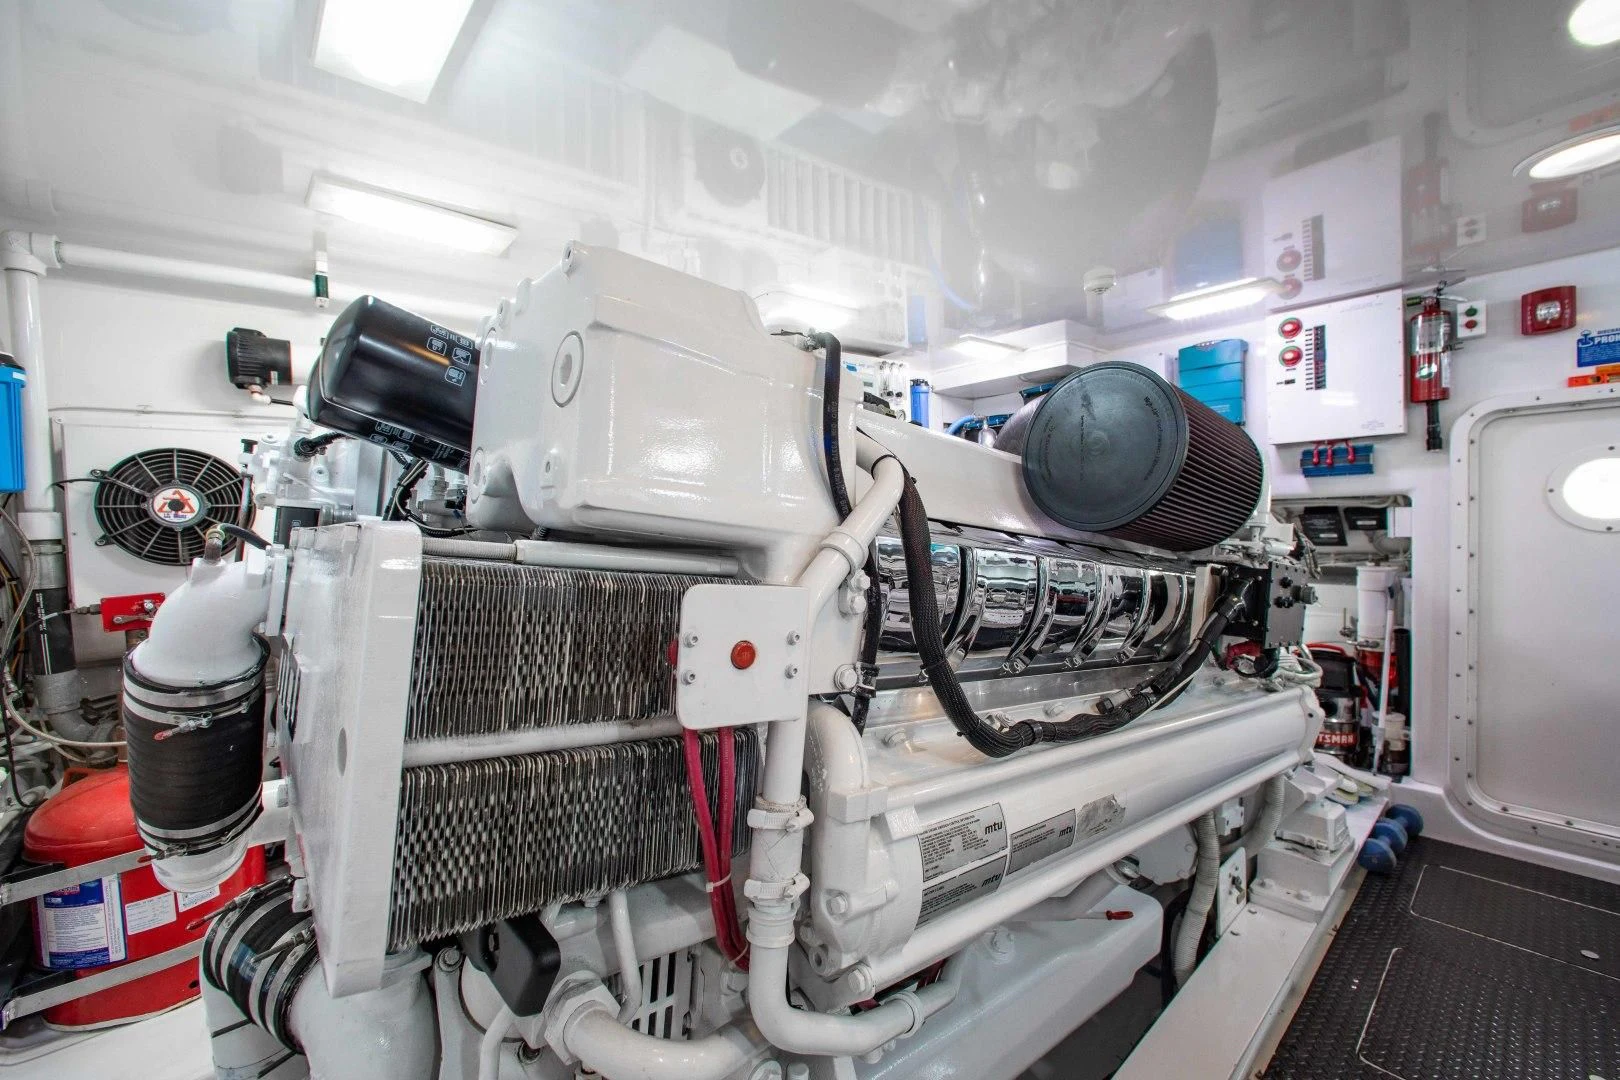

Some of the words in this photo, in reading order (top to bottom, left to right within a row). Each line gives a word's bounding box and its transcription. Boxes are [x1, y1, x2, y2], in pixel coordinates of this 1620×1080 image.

[984, 821, 1003, 835] mtu
[1058, 825, 1074, 838] mtu
[981, 873, 1002, 888] mtu
